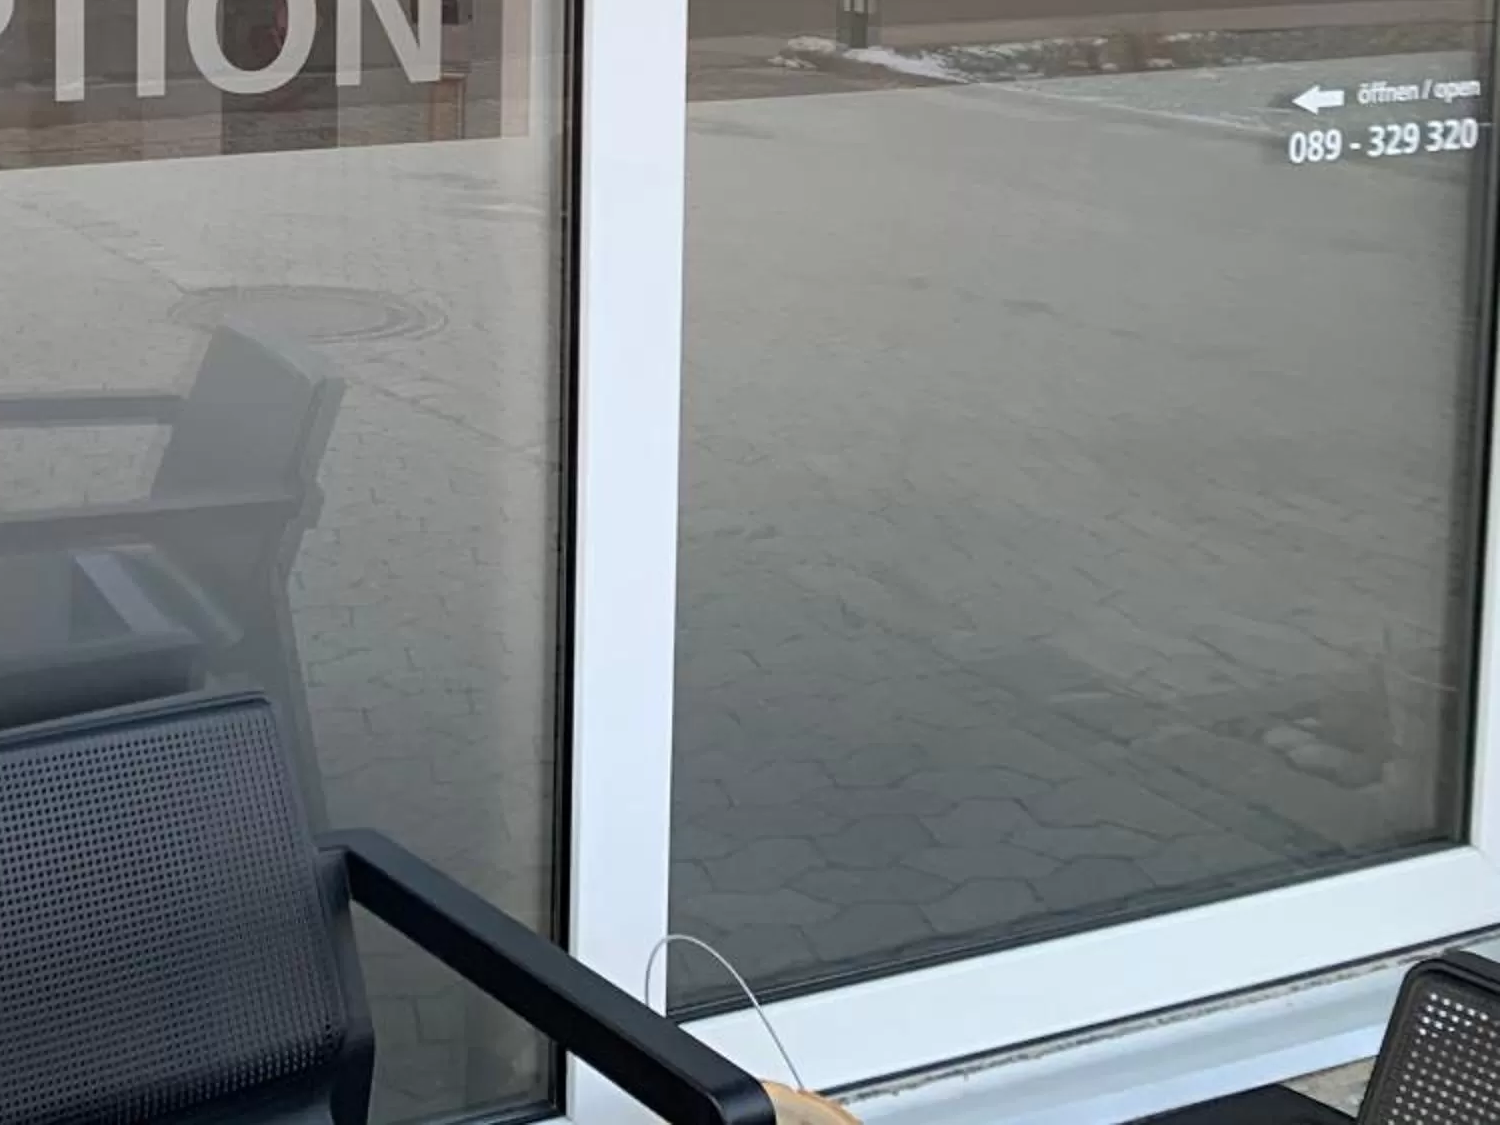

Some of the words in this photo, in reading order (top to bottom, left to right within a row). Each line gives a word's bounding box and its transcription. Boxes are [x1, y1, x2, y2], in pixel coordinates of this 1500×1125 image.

[1433, 80, 1481, 104] open
[1288, 128, 1342, 164] 089
[1366, 122, 1420, 158] 329
[1424, 118, 1479, 152] 320
